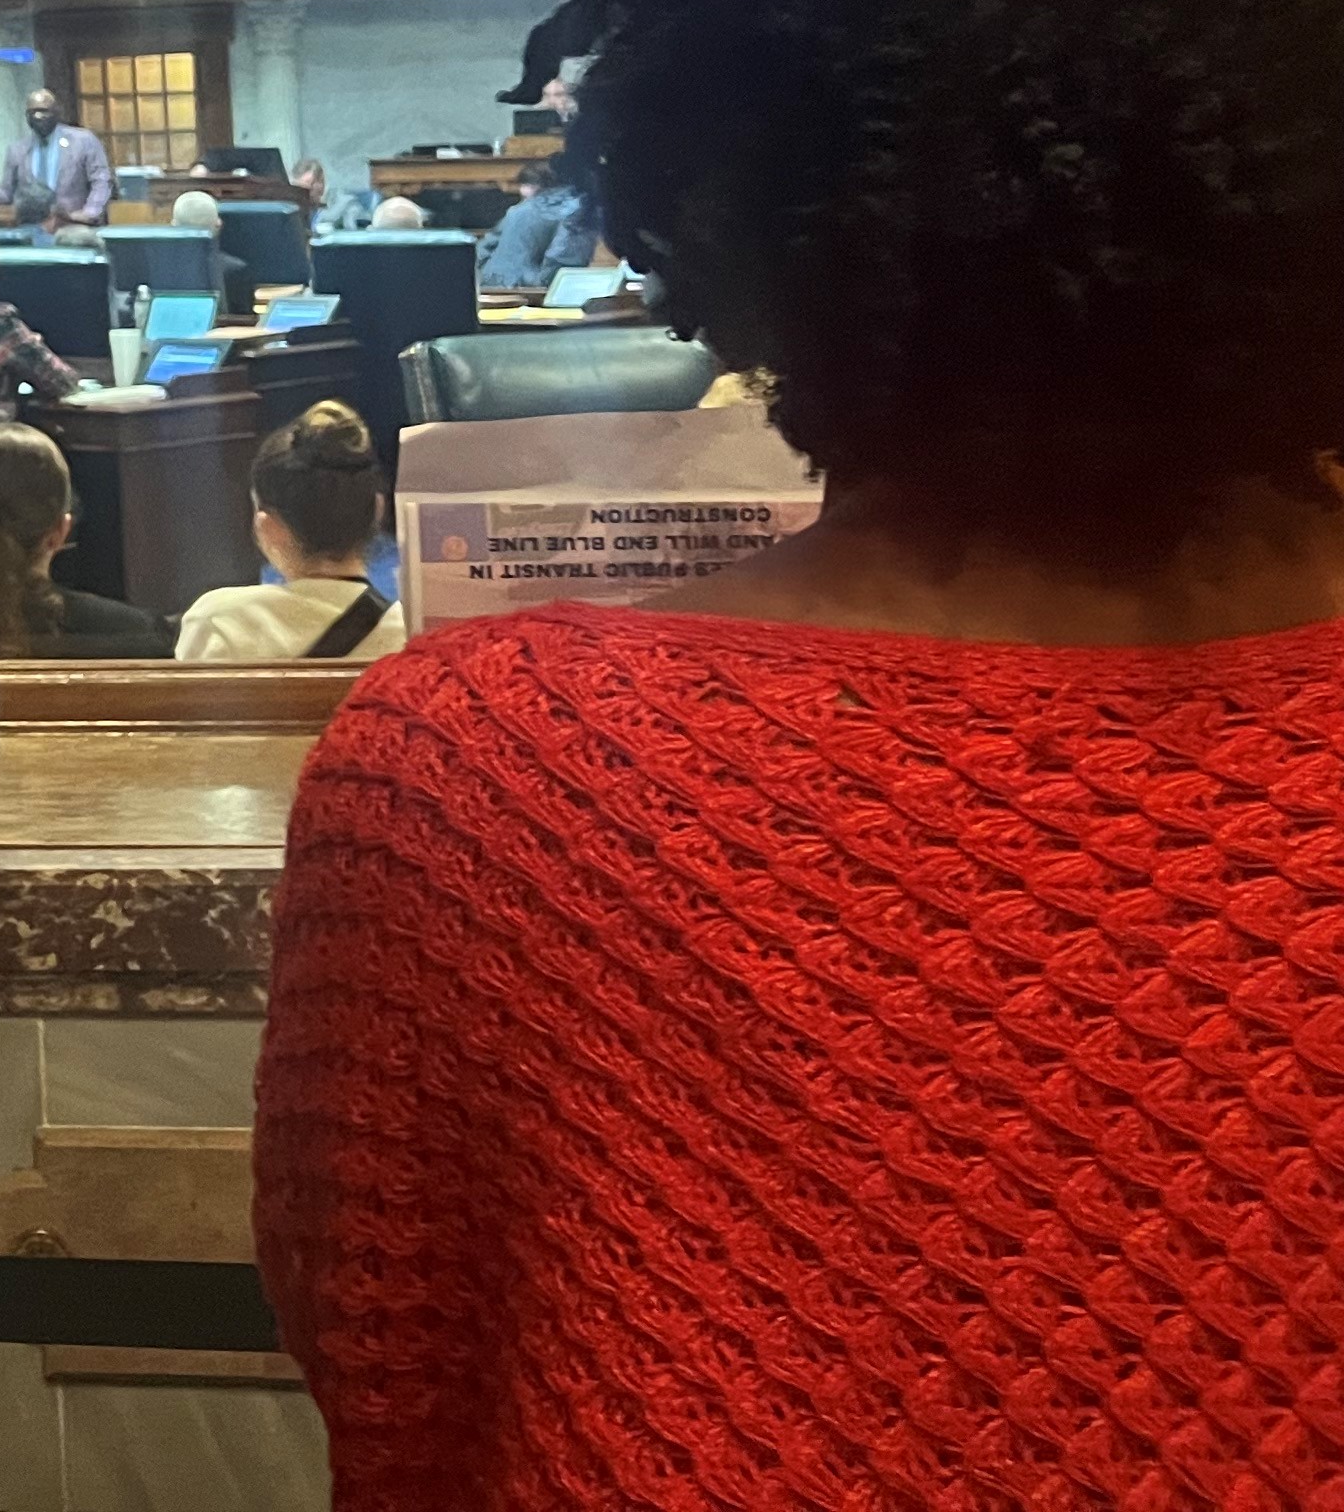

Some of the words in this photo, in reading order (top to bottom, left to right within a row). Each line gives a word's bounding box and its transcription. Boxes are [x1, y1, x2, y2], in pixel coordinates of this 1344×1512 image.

[591, 507, 771, 523] CONSTRUCTION
[488, 537, 539, 552] LINE
[547, 536, 605, 551] BLUE
[614, 536, 657, 550] END
[665, 535, 719, 550] WILL
[726, 535, 773, 549] AND
[469, 565, 493, 579] IN
[501, 562, 596, 579] TRANSIT
[603, 562, 688, 578] PUBLIC
